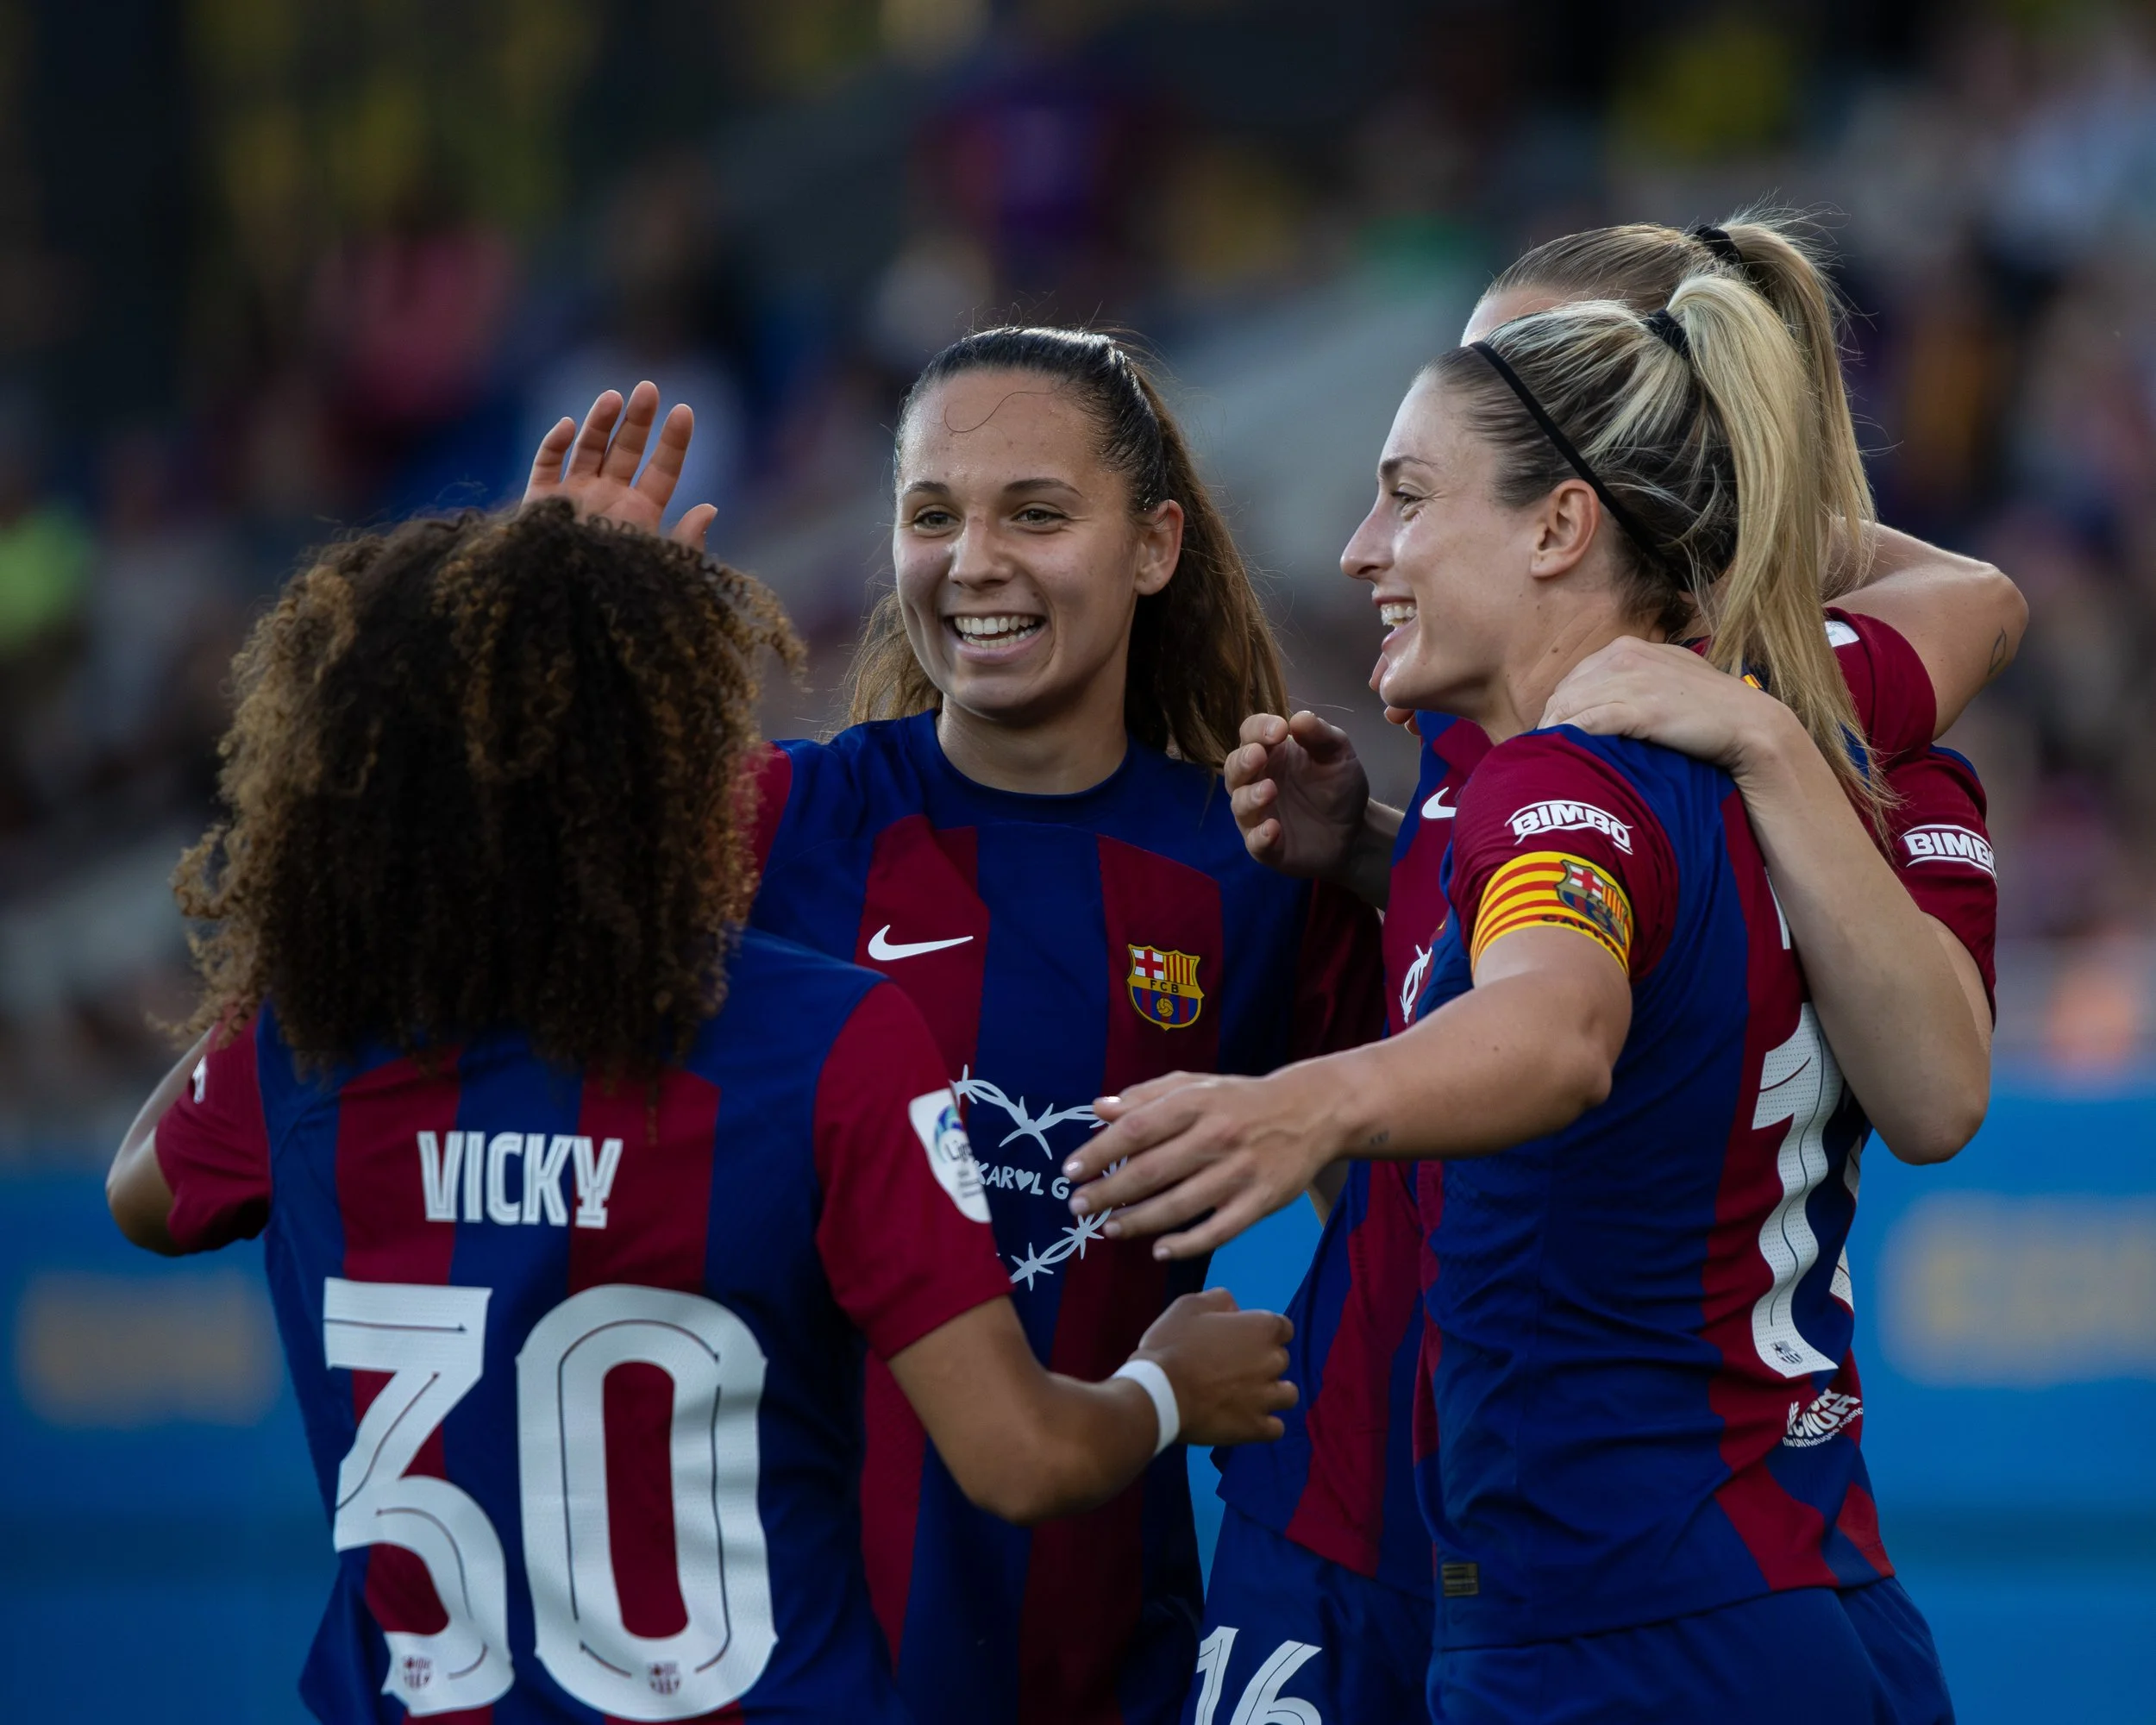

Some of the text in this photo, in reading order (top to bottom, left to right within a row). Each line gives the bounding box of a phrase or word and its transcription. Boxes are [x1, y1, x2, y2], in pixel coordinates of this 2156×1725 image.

[1511, 803, 1633, 850] BIMBO
[1150, 979, 1179, 994] FCB
[417, 1130, 624, 1229] VICKY
[1050, 1176, 1070, 1200] G
[323, 1277, 779, 1722] 30
